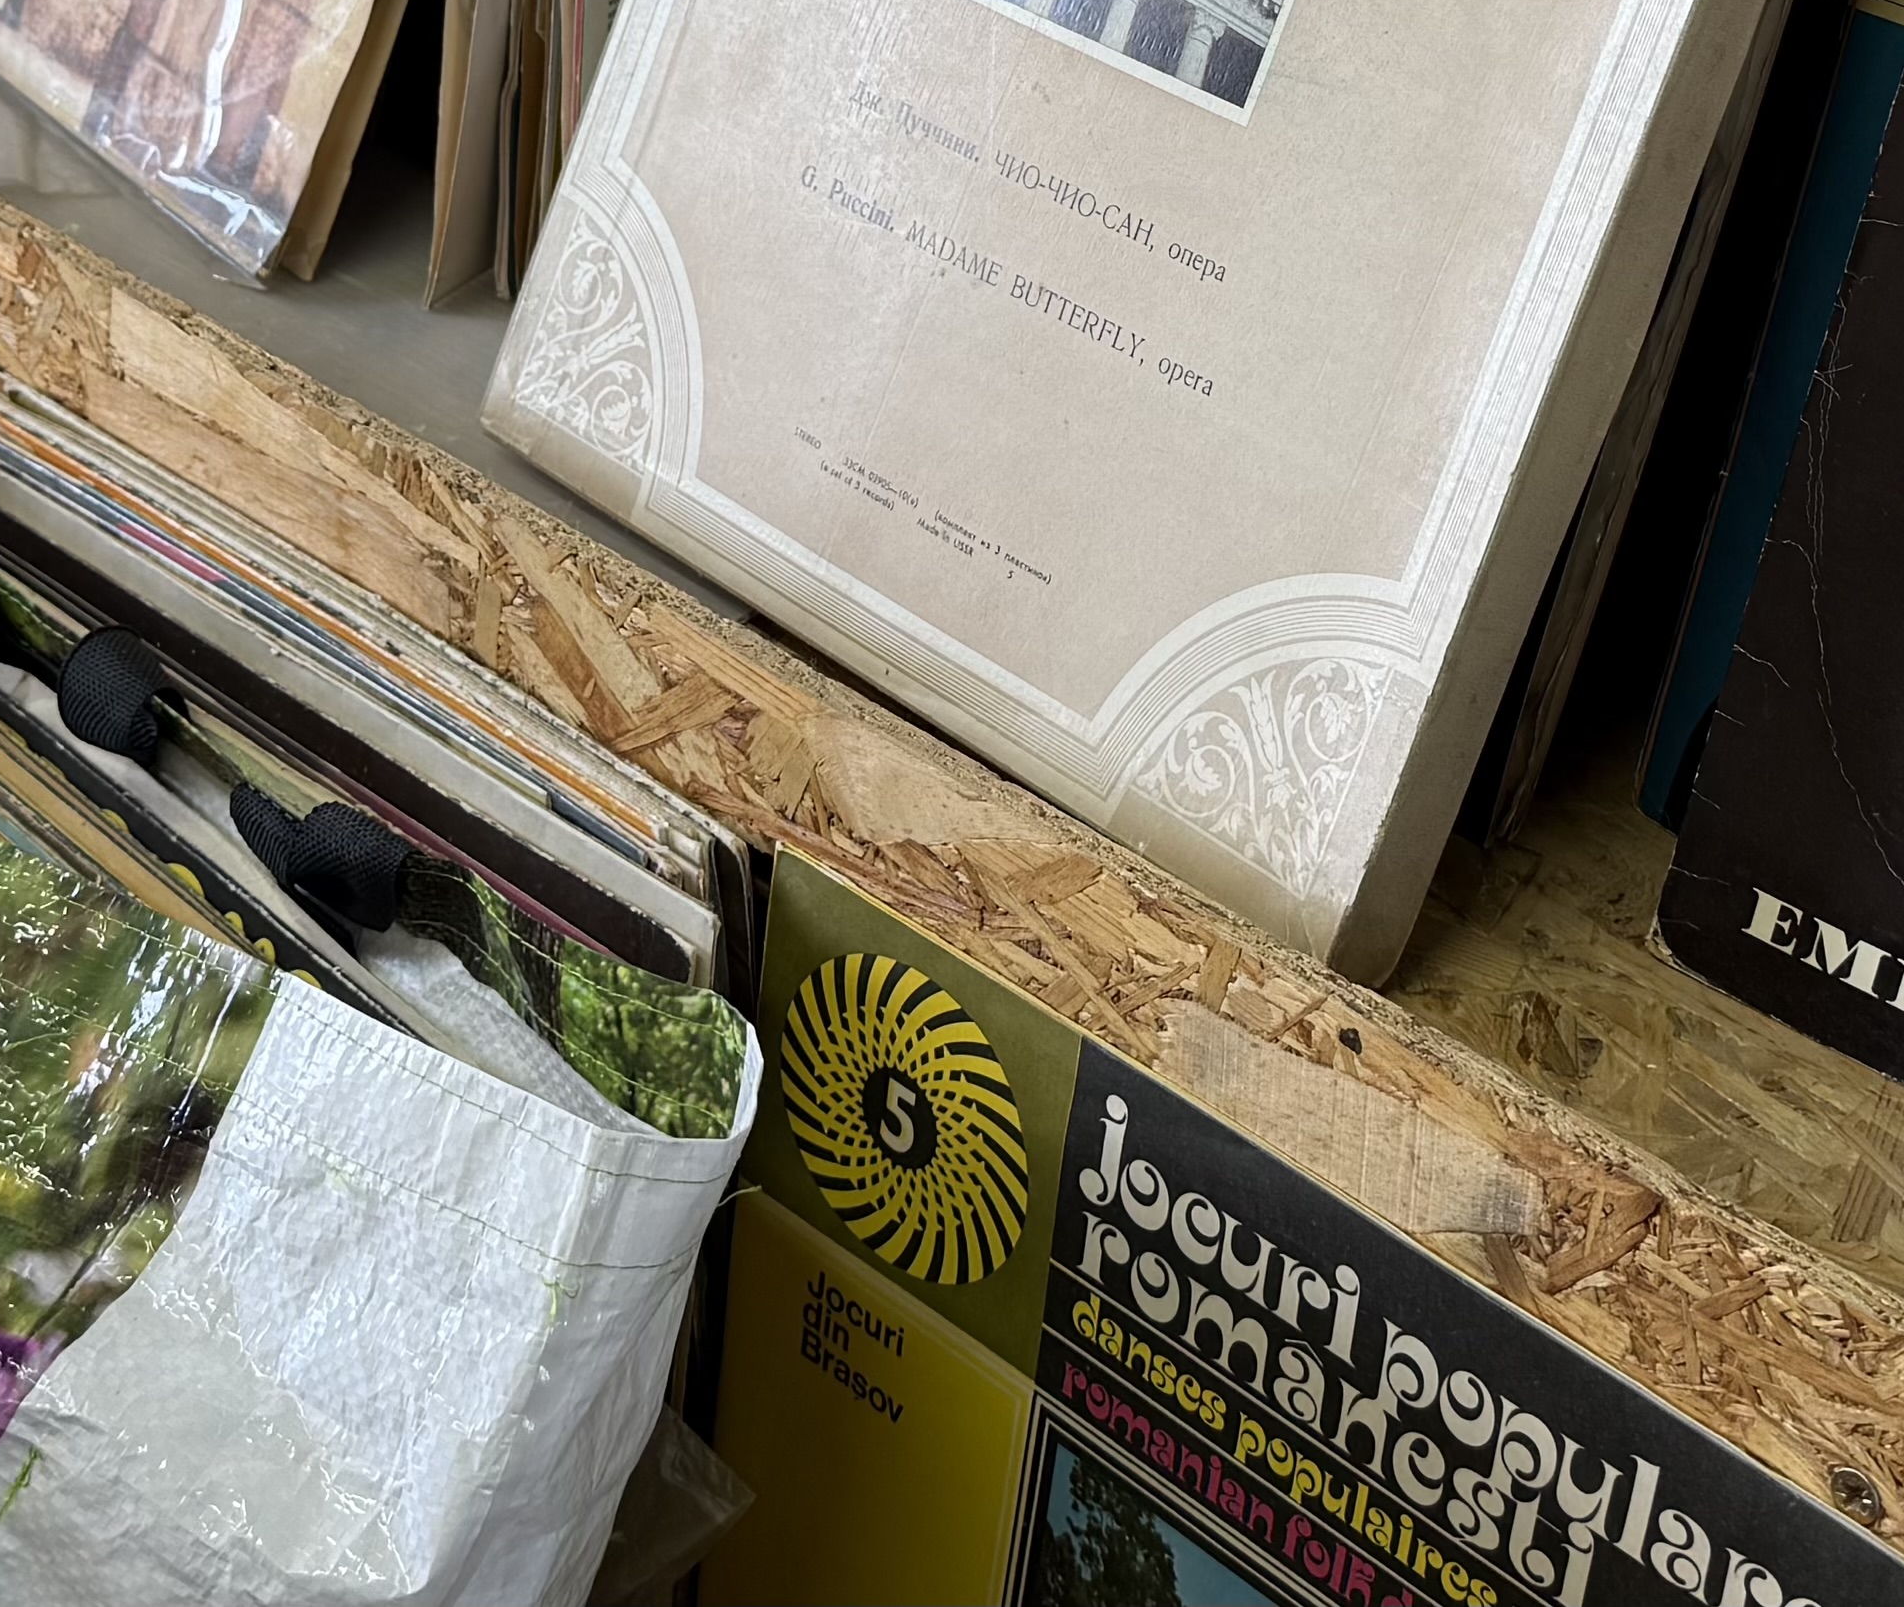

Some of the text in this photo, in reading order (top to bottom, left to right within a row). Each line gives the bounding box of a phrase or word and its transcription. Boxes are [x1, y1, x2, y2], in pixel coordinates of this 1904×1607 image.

[800, 164, 1215, 398] G. Puccini. MADAME BUTTERFLY, opera
[848, 80, 1228, 283] Дж. Пуччини. ЧИО-ЧИО-САН, опера
[877, 1076, 916, 1156] 5
[801, 1299, 853, 1356] din
[802, 1266, 907, 1361] Jocuri
[1071, 1295, 1227, 1434] danses
[1076, 1091, 1858, 1606] jocuri popular
[1059, 1360, 1376, 1600] romanian folk
[1237, 1403, 1499, 1606] populaires
